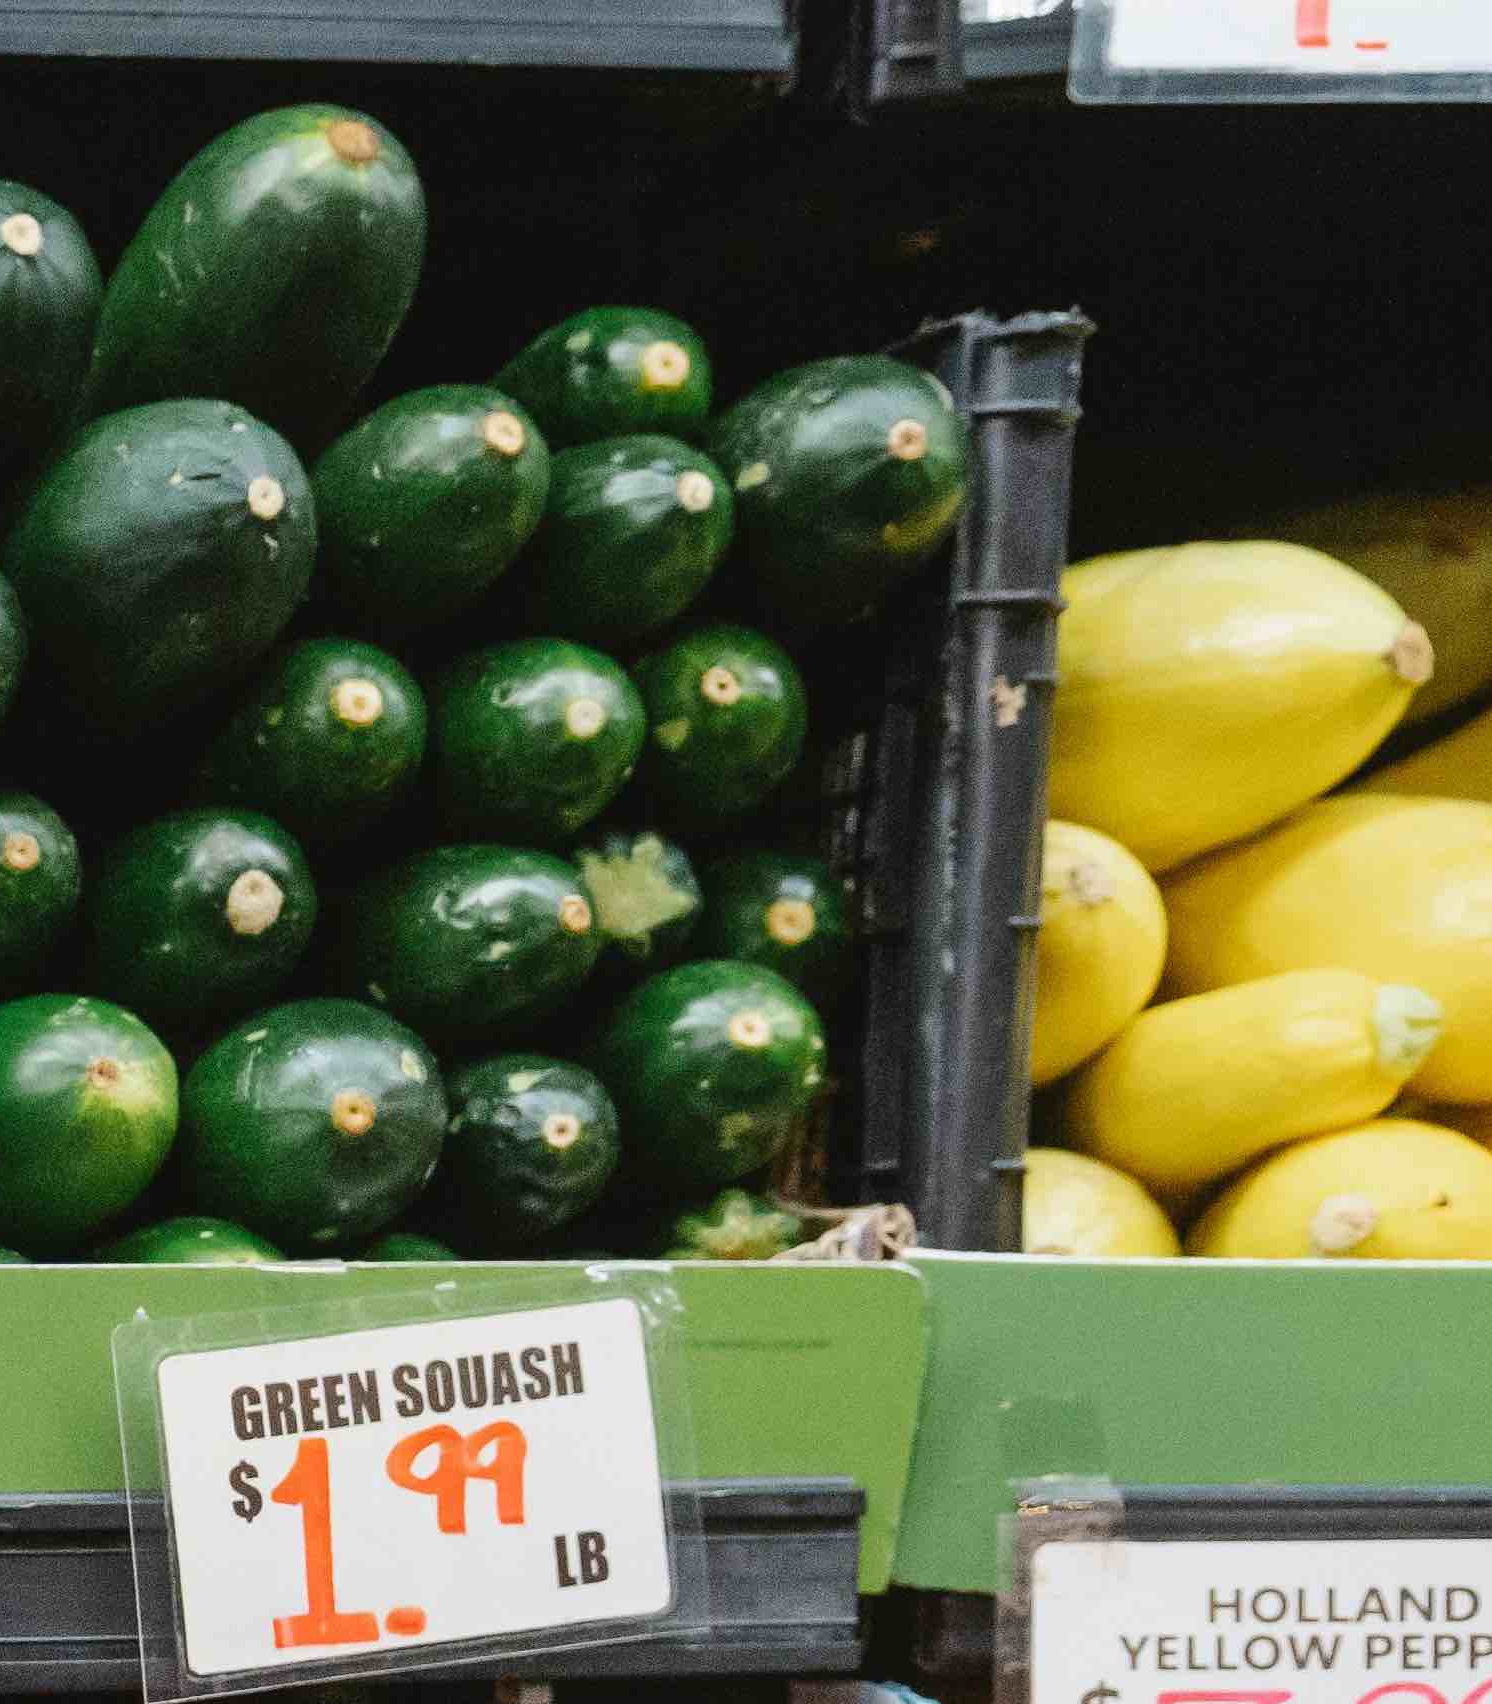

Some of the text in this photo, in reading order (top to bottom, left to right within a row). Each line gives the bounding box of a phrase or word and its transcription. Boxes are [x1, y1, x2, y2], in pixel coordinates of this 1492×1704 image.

[231, 1342, 586, 1441] GREEN SQUASH
[553, 1530, 612, 1589] LB
[1207, 1586, 1481, 1624] HOLLAND
[1119, 1633, 1344, 1671] YELLOW
